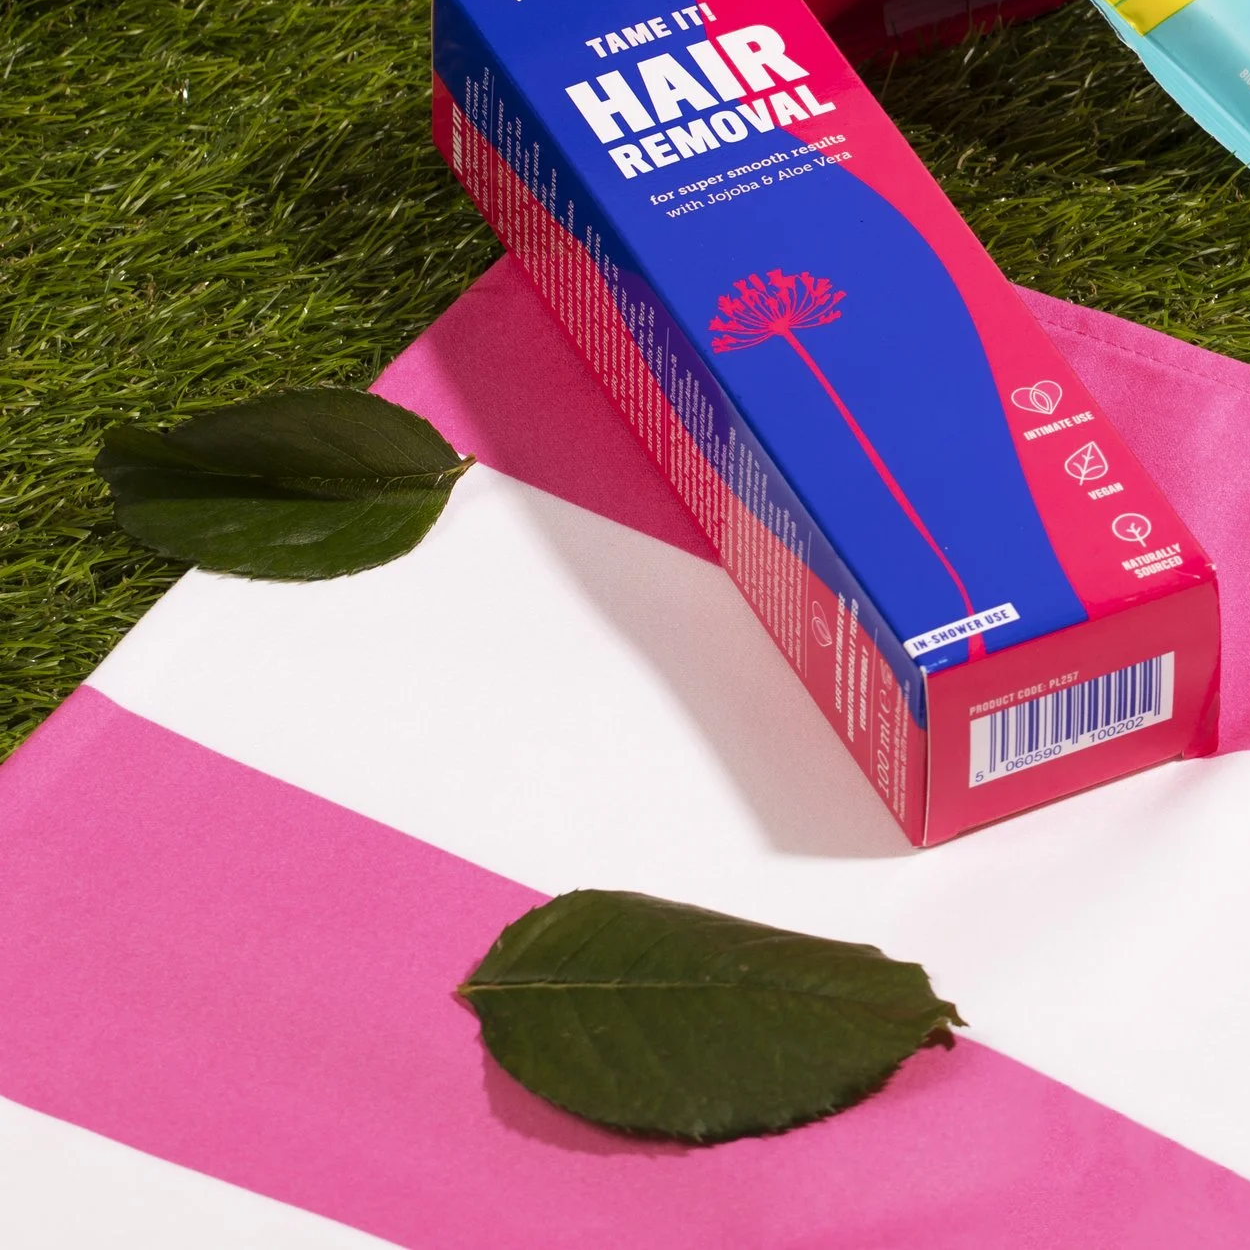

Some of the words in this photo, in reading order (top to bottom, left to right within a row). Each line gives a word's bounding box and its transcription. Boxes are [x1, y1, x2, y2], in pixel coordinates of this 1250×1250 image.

[586, 18, 672, 58] TAME
[672, 2, 717, 30] IT!
[564, 24, 810, 144] HAIR
[452, 103, 461, 130] IT!
[608, 84, 836, 180] REMOVAL
[452, 127, 462, 173] TAME
[650, 190, 675, 206] for
[678, 174, 724, 196] super
[727, 152, 790, 179] smooth
[793, 134, 846, 157] results
[666, 200, 704, 218] with
[708, 180, 760, 206] Jojoba
[762, 174, 773, 186] &
[778, 162, 813, 181] Aloe
[814, 151, 852, 168] Vera
[1024, 418, 1076, 441] INTIMATE
[1074, 411, 1095, 426] USE
[1088, 482, 1124, 500] VEGAN
[1121, 543, 1182, 570] NATURALLY
[1134, 555, 1184, 578] SOURCED
[837, 593, 845, 615] USE
[835, 614, 843, 664] INTIMATE
[913, 618, 984, 652] IN-SHOWER
[986, 609, 1010, 624] USE
[969, 693, 1014, 716] PRODUCT
[1017, 683, 1046, 701] CODE:
[1048, 671, 1080, 690] PL257
[877, 713, 889, 751] ml
[975, 772, 984, 783] 5
[1005, 745, 1062, 772] 060590
[1090, 716, 1144, 742] 100202
[876, 750, 889, 796] 100
